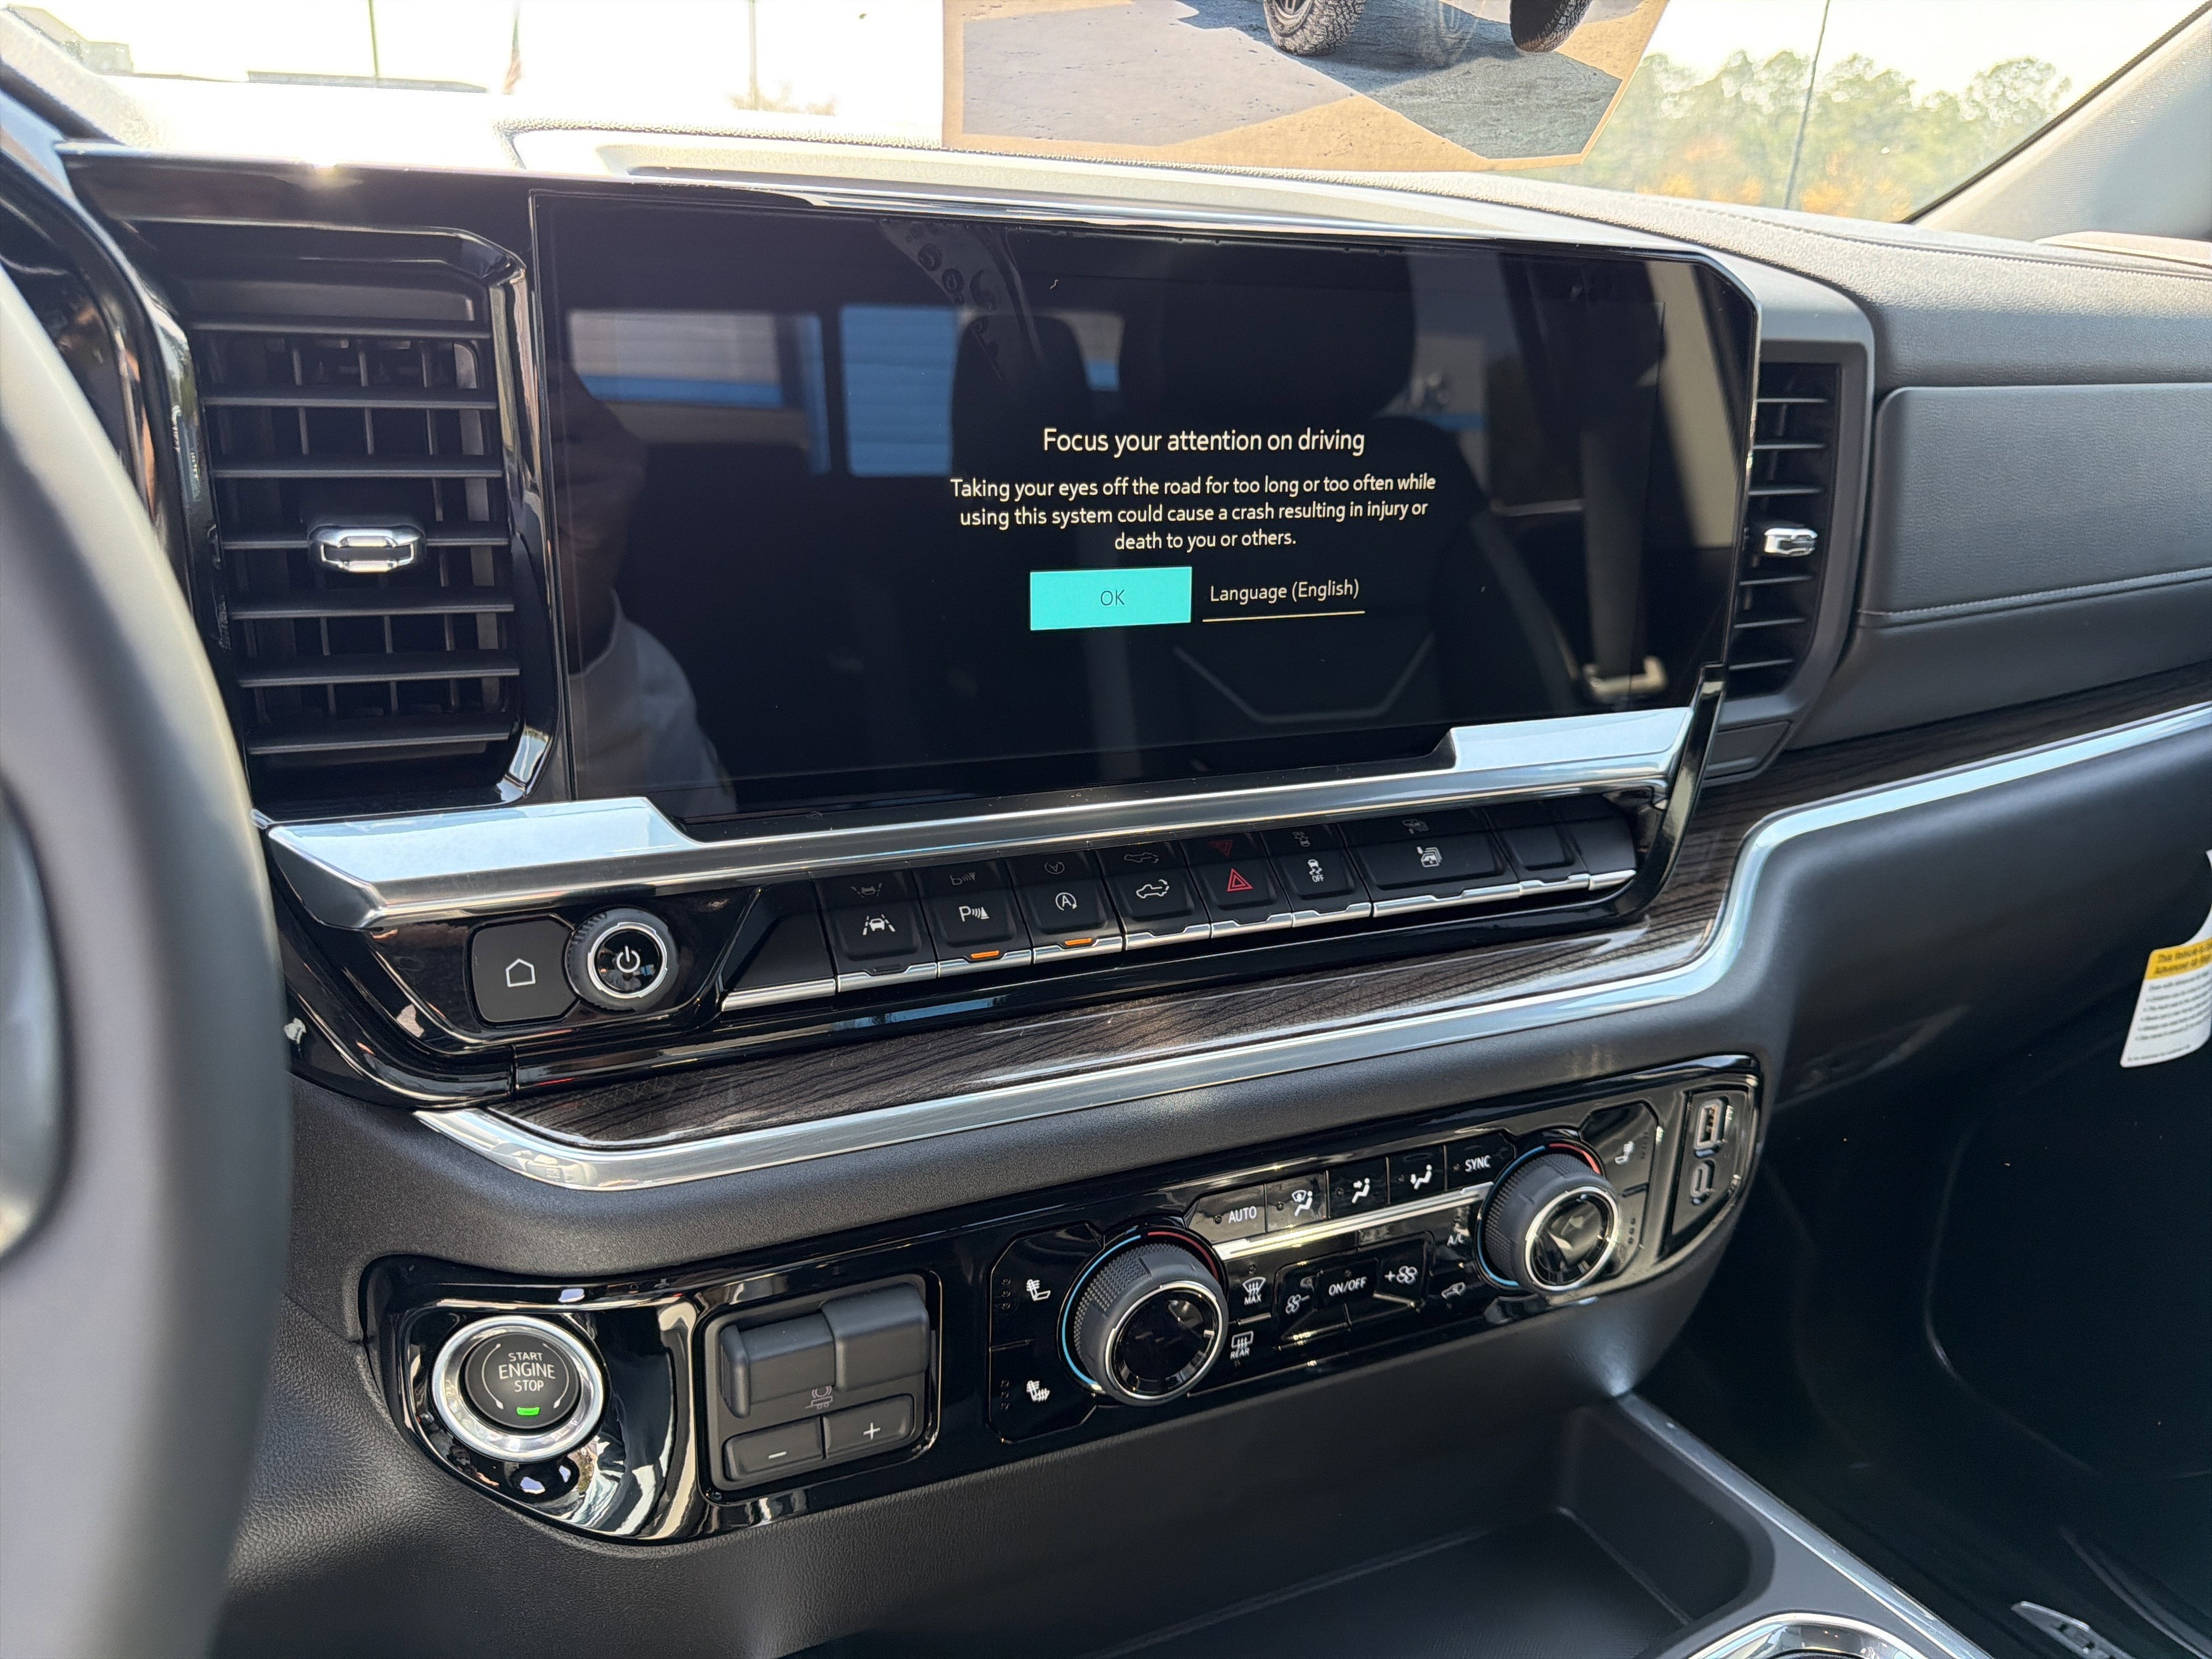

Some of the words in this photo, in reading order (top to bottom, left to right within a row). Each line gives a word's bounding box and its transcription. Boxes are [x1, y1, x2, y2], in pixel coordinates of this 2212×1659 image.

[1044, 427, 1109, 452] Focus
[1114, 435, 1163, 459] your
[1167, 429, 1262, 452] attention
[1267, 434, 1293, 451] on
[1298, 427, 1365, 456] driving
[950, 477, 1010, 502] Taking
[1014, 483, 1055, 502] your
[1058, 482, 1098, 501] eyes
[1102, 476, 1130, 495] off
[1131, 476, 1159, 495] the
[1164, 476, 1201, 495] road
[1205, 476, 1230, 494] for
[1233, 478, 1260, 493] too
[1265, 475, 1299, 498] long
[1303, 479, 1321, 492] or
[1323, 476, 1350, 492] too
[1353, 473, 1393, 491] often
[1397, 472, 1436, 490] while
[960, 508, 1009, 531] using
[1014, 506, 1047, 524] this
[1052, 507, 1113, 529] system
[1118, 504, 1163, 523] could
[1167, 509, 1214, 522] cause
[1218, 508, 1228, 521] a
[1232, 501, 1274, 520] crash
[1279, 500, 1346, 522] resulting
[1350, 501, 1363, 517] in
[1367, 500, 1409, 521] injury
[1411, 503, 1429, 515] or
[1114, 531, 1162, 550] death
[1166, 533, 1183, 549] to
[1186, 535, 1216, 553] you
[1220, 534, 1238, 547] or
[1241, 528, 1296, 546] others.
[1101, 589, 1125, 606] OK
[1211, 585, 1288, 605] Language
[1292, 578, 1359, 602] (English)
[1312, 874, 1324, 883] OFF
[1465, 1155, 1492, 1172] SYNC
[1228, 1206, 1257, 1224] AUTO
[1328, 1276, 1368, 1296] ON/OFF
[1244, 1293, 1262, 1306] MAX
[508, 1352, 543, 1362] START
[1229, 1347, 1250, 1361] REAR
[498, 1362, 556, 1380] ENGINE
[514, 1379, 544, 1392] STOP
